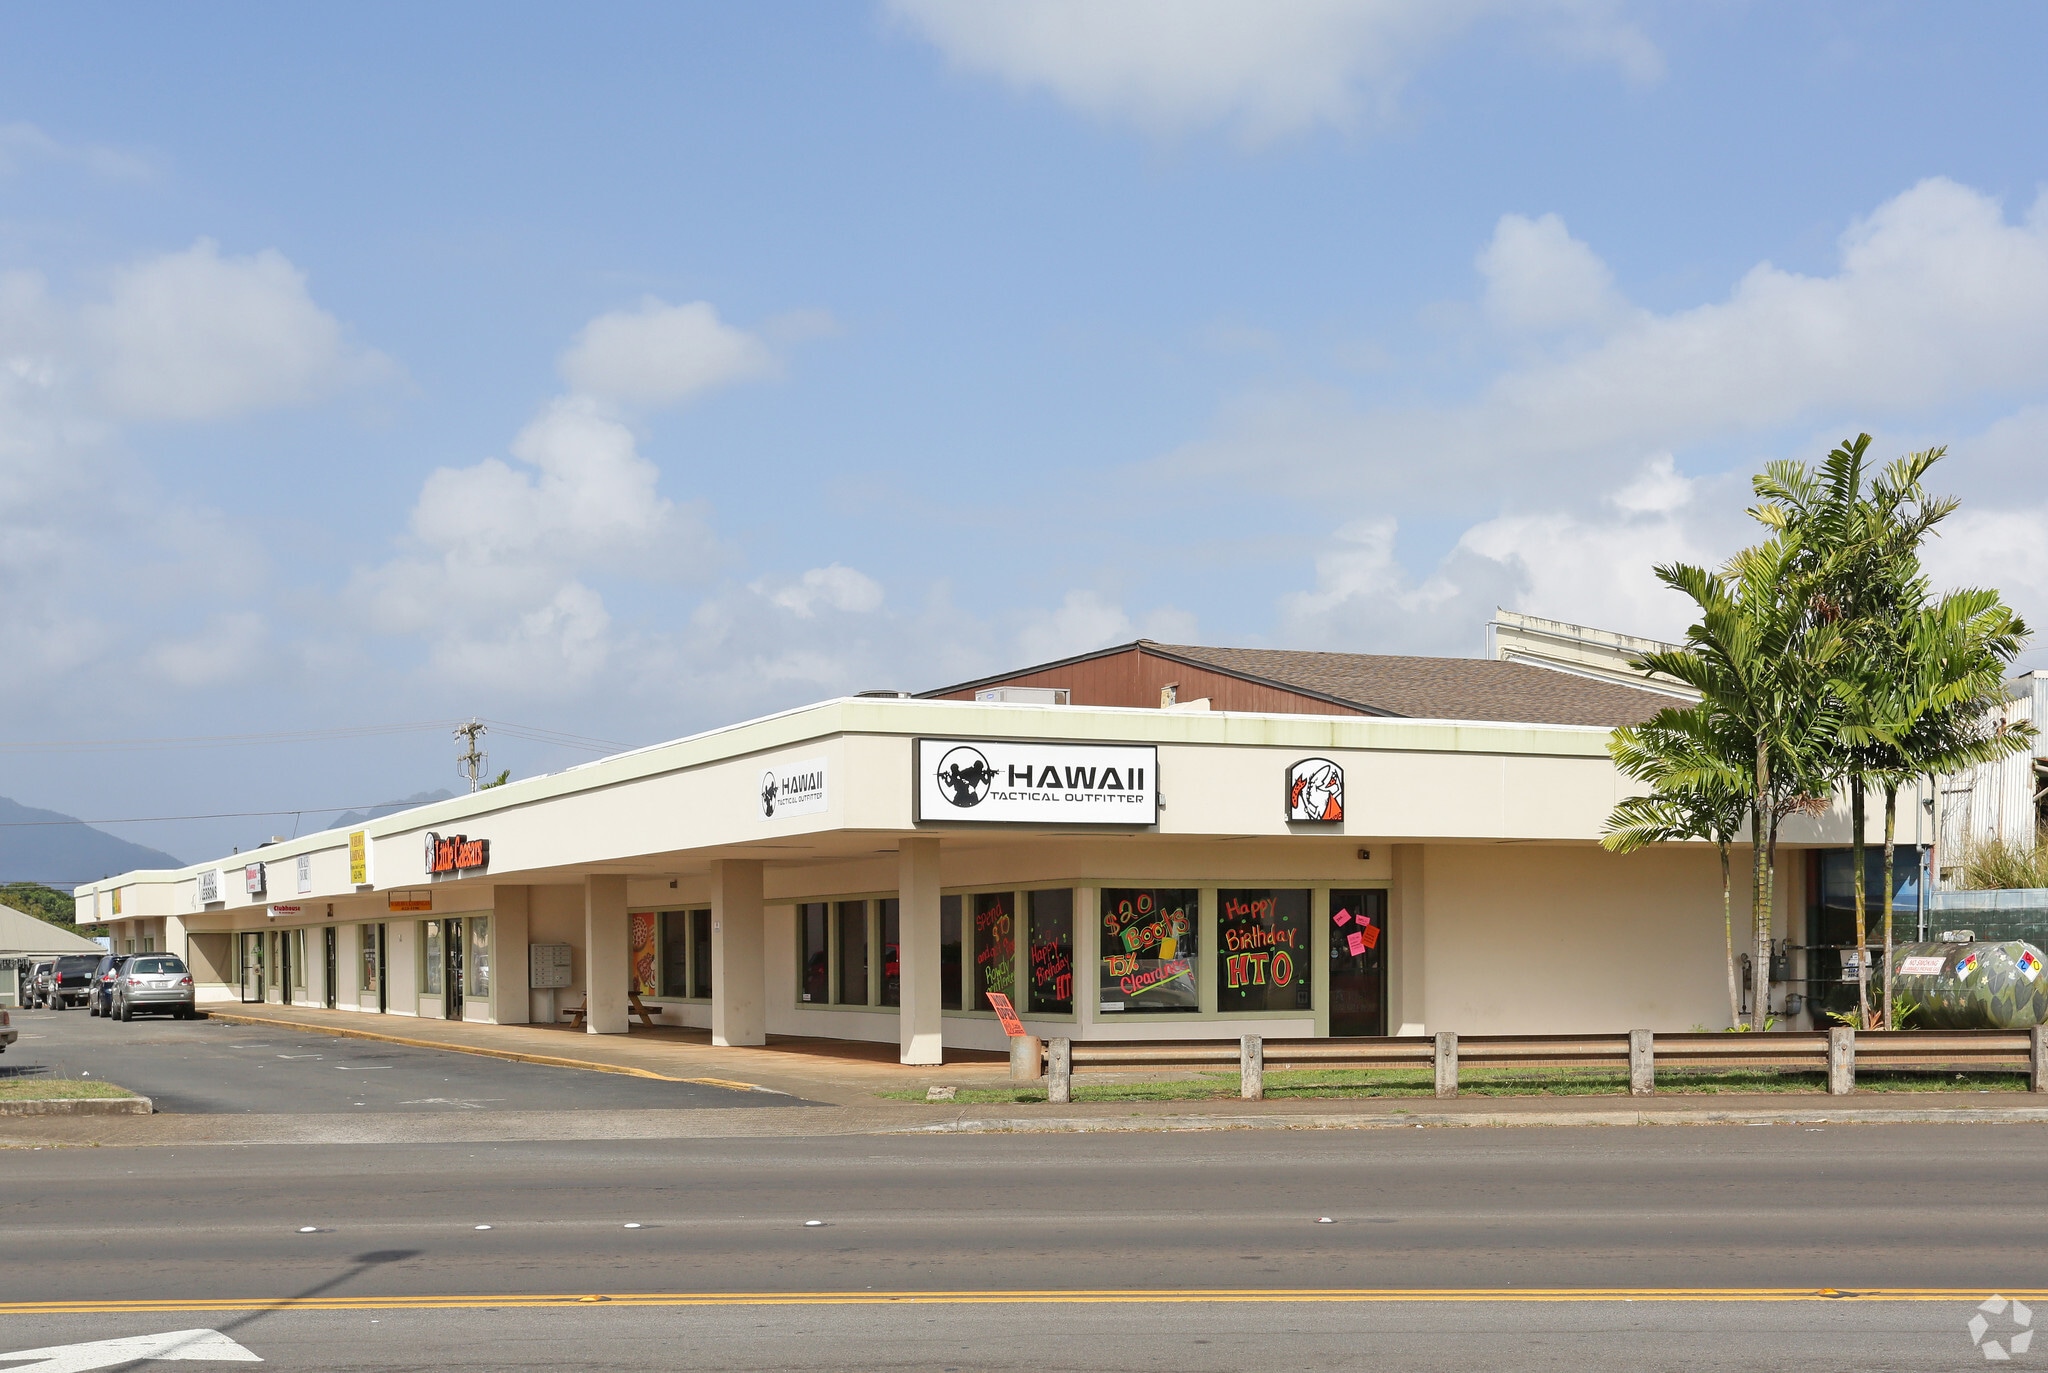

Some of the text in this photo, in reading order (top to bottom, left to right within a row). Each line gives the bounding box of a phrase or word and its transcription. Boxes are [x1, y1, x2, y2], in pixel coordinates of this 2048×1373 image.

[782, 771, 823, 796] HAWAII
[1008, 764, 1144, 791] HAWAII
[990, 791, 1144, 804] TACTICAL OUTFITTER
[435, 836, 483, 871] Little Caesars
[1104, 894, 1153, 936] $20
[1225, 897, 1278, 920] Happy
[1126, 907, 1190, 951] Boots
[1225, 923, 1297, 951] Birthday
[1031, 937, 1059, 967] Happy
[2033, 961, 2040, 971] 0
[1036, 953, 1070, 987] Birthday
[1226, 950, 1293, 988] HTO
[1056, 972, 1073, 1001] HT
